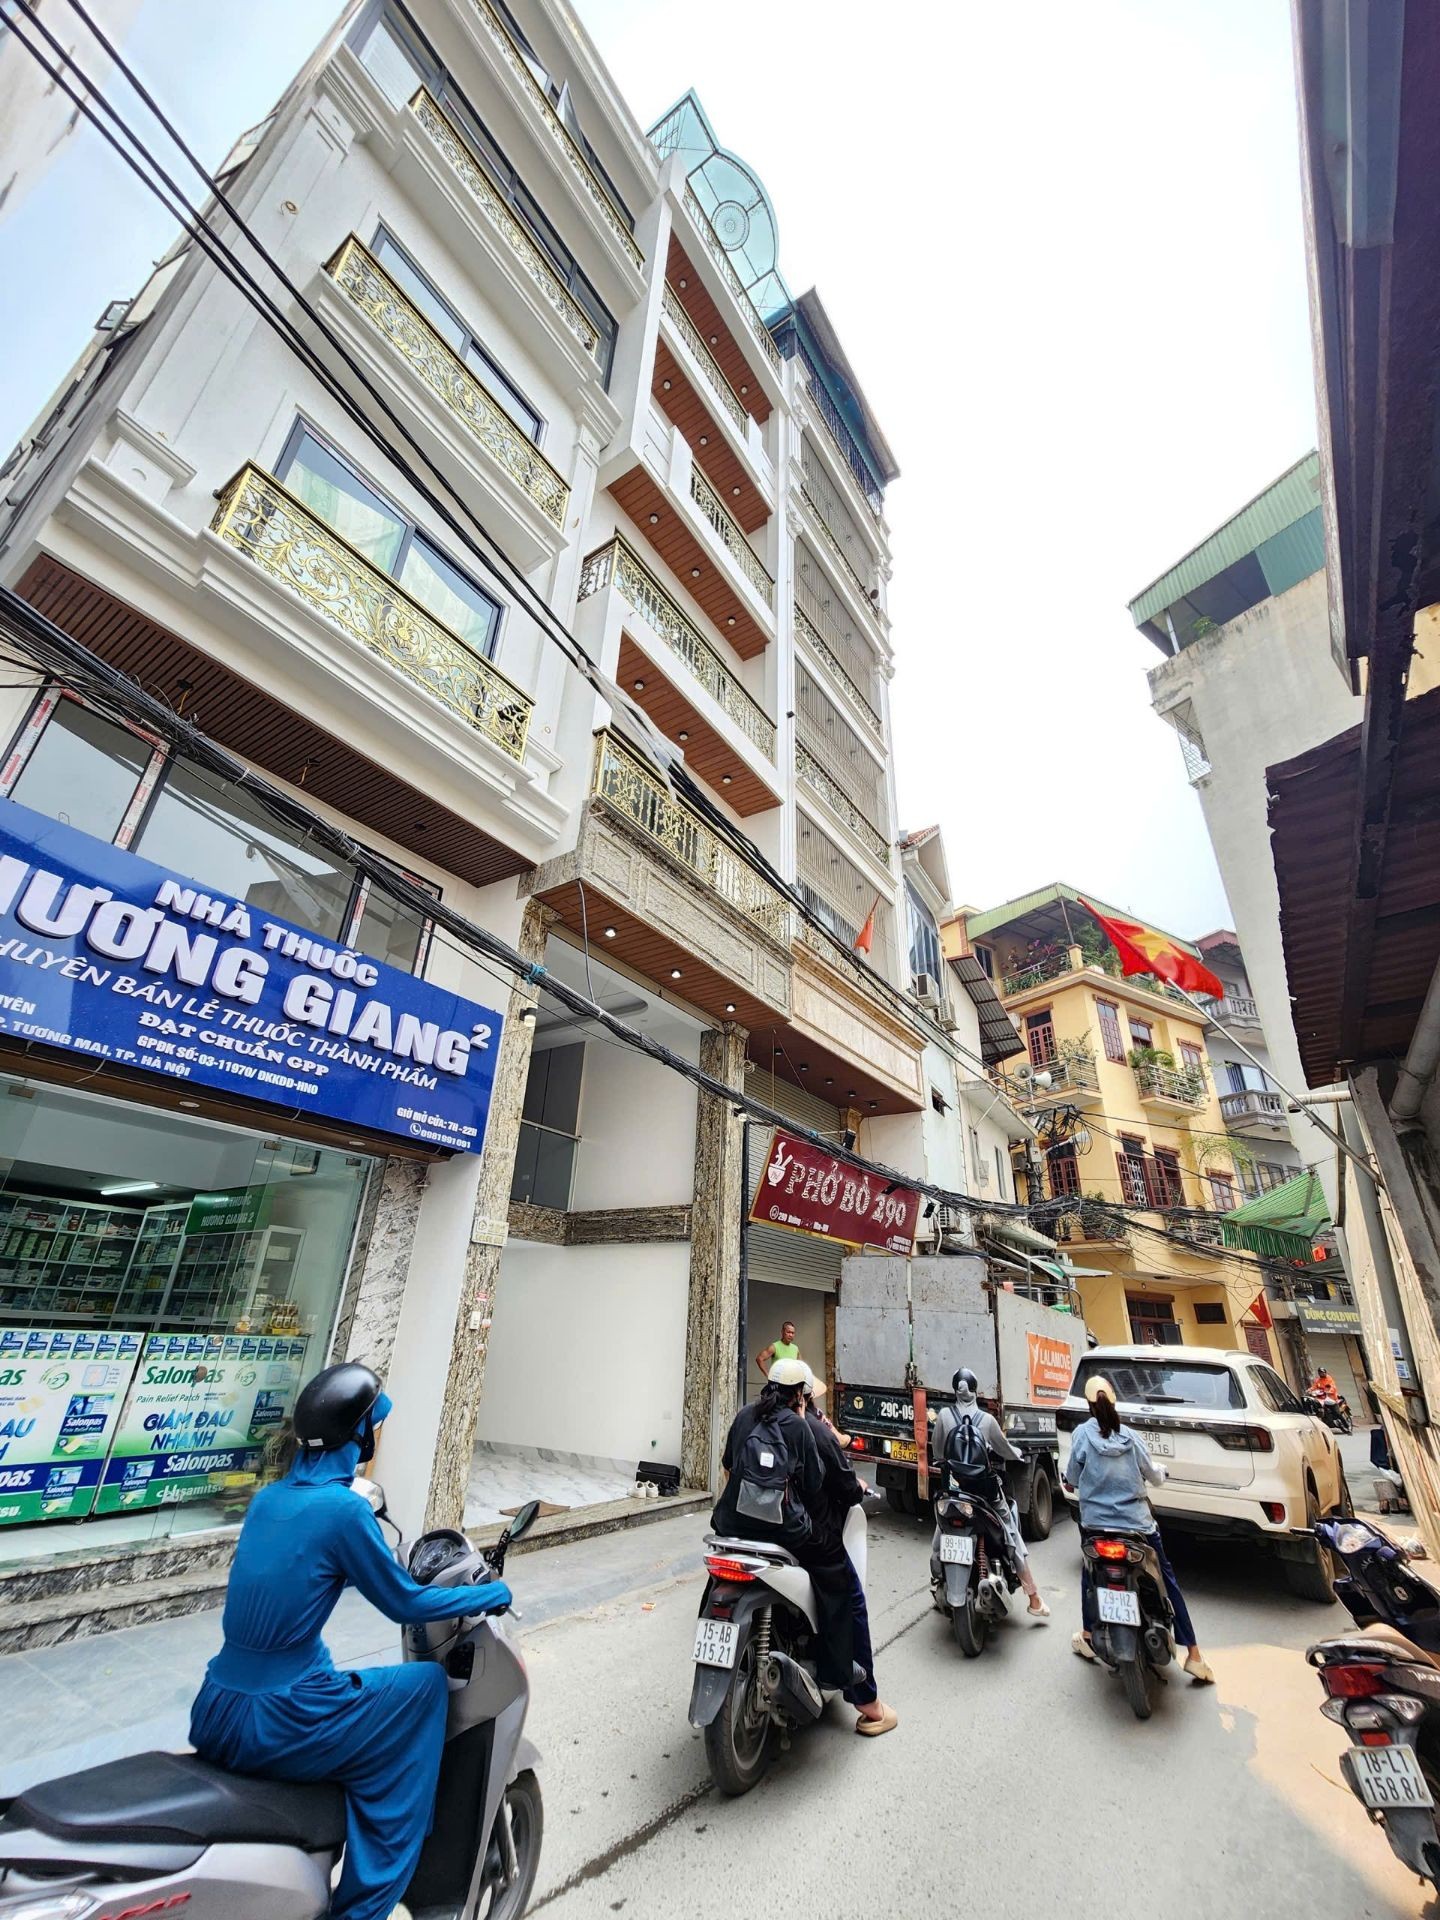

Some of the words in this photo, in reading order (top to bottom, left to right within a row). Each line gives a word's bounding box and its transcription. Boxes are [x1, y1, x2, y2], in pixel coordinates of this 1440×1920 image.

[155, 880, 251, 939] NHÀ
[263, 922, 379, 988] THUỐC
[112, 975, 183, 1009] BÁN
[182, 998, 220, 1020] LẺ
[220, 1008, 306, 1047] THUỐC
[307, 1036, 382, 1073] THÀNH
[381, 1061, 438, 1091] PHẨM
[138, 1011, 197, 1038] ĐẠT
[198, 1030, 285, 1065] CHUẨN
[286, 1056, 330, 1077] GPP
[12, 1020, 73, 1046] TƯƠNG
[140, 1055, 162, 1071] HÀ
[164, 1060, 192, 1078] NỘI
[785, 1160, 843, 1206] PHỞ
[839, 1175, 871, 1216] BÒ
[872, 1193, 908, 1229] 290
[142, 1365, 225, 1388] Salonas
[136, 1395, 154, 1403] Pain
[155, 1393, 179, 1402] Relief
[179, 1392, 200, 1401] Patch
[65, 1416, 104, 1427] Salonpas
[195, 1409, 235, 1429] ĐAU
[150, 1430, 217, 1450] NHANH
[163, 1453, 234, 1474] Salonpas
[704, 1622, 733, 1644] 15-AB
[694, 1640, 731, 1665] 315.21
